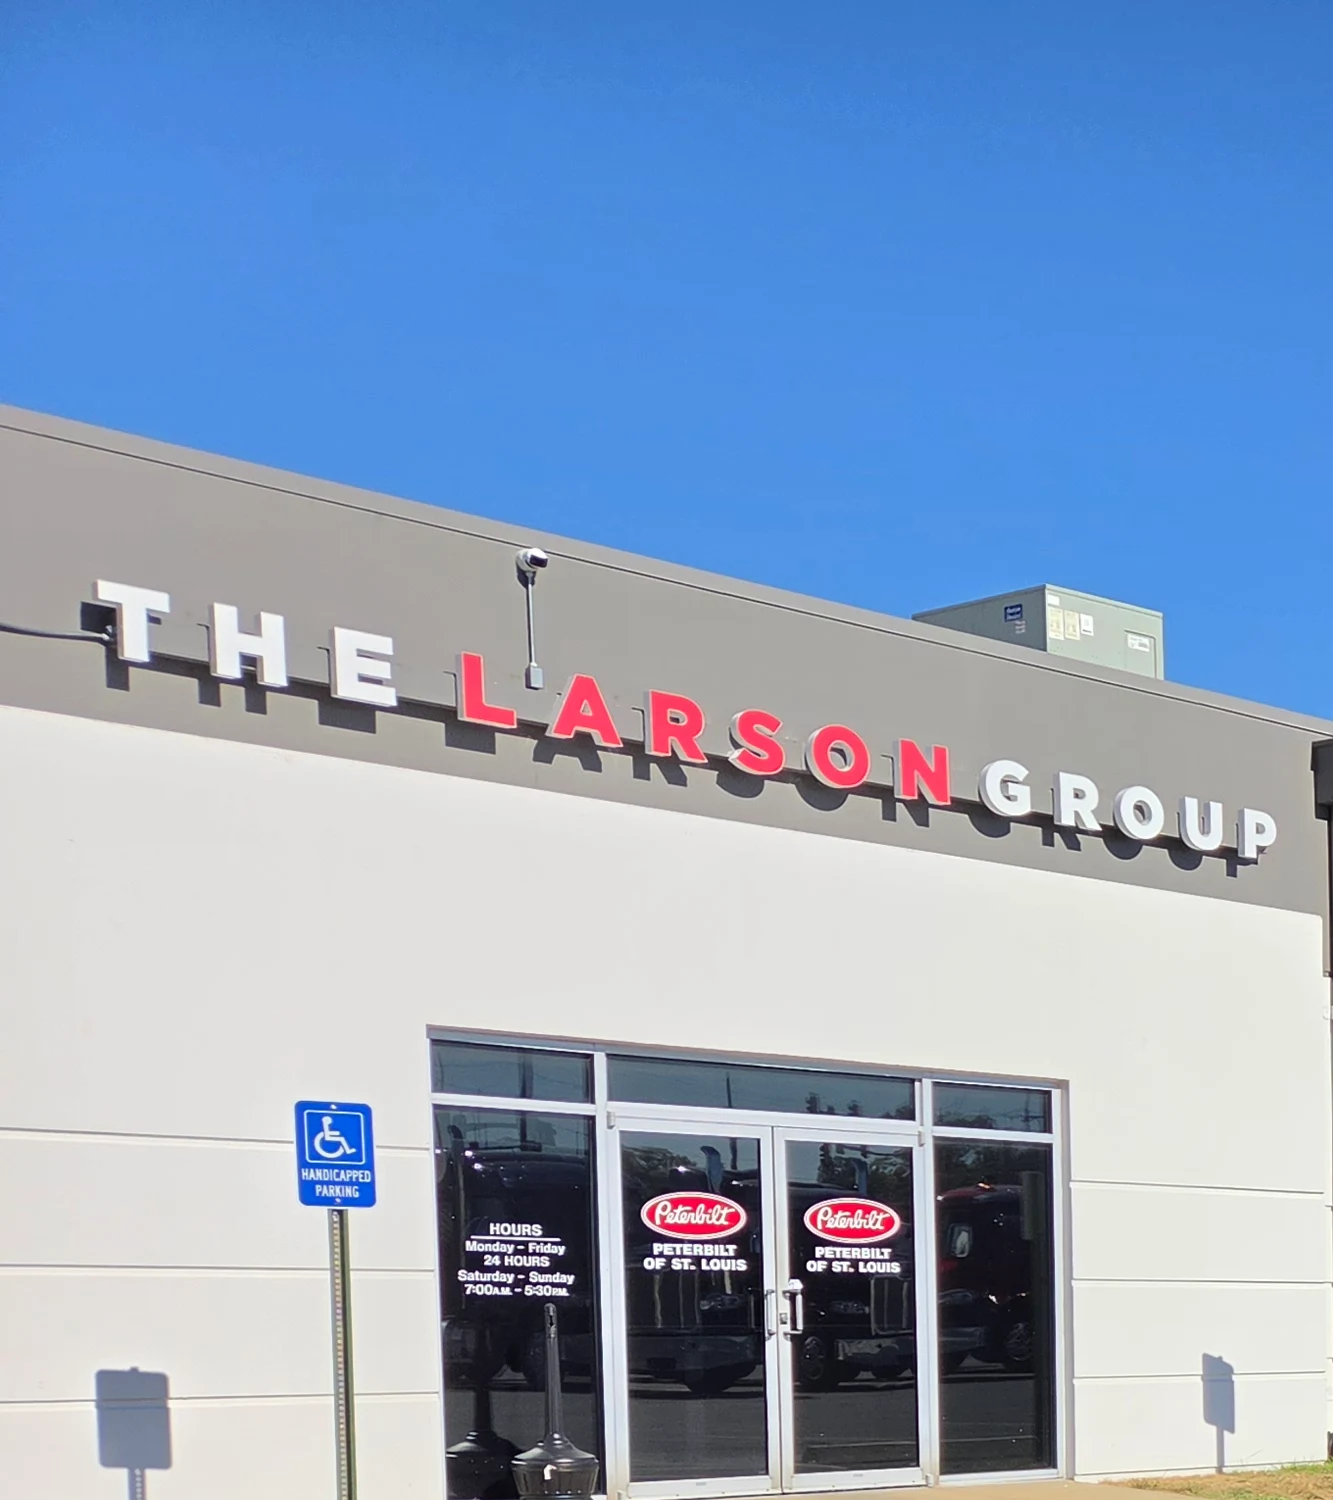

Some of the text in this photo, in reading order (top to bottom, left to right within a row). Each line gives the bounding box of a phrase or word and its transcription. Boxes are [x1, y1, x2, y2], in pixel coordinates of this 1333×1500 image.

[93, 579, 1277, 859] THE LARSON GROUP
[301, 1167, 371, 1183] HANDICAPPED
[315, 1184, 360, 1198] PARKING
[655, 1200, 736, 1226] Peterbilt
[816, 1206, 891, 1231] Peterbilt
[489, 1222, 543, 1236] HOURS
[465, 1240, 515, 1254] Monday
[528, 1242, 567, 1256] Friday
[653, 1243, 737, 1257] PETERBILT
[814, 1247, 892, 1260] PETERBILT
[483, 1254, 550, 1267] 24 HOURS
[643, 1258, 747, 1271] OF ST. LOUIS
[806, 1260, 901, 1274] OF ST. LOUIS
[457, 1269, 516, 1284] Saturday
[528, 1271, 576, 1285] Sunday
